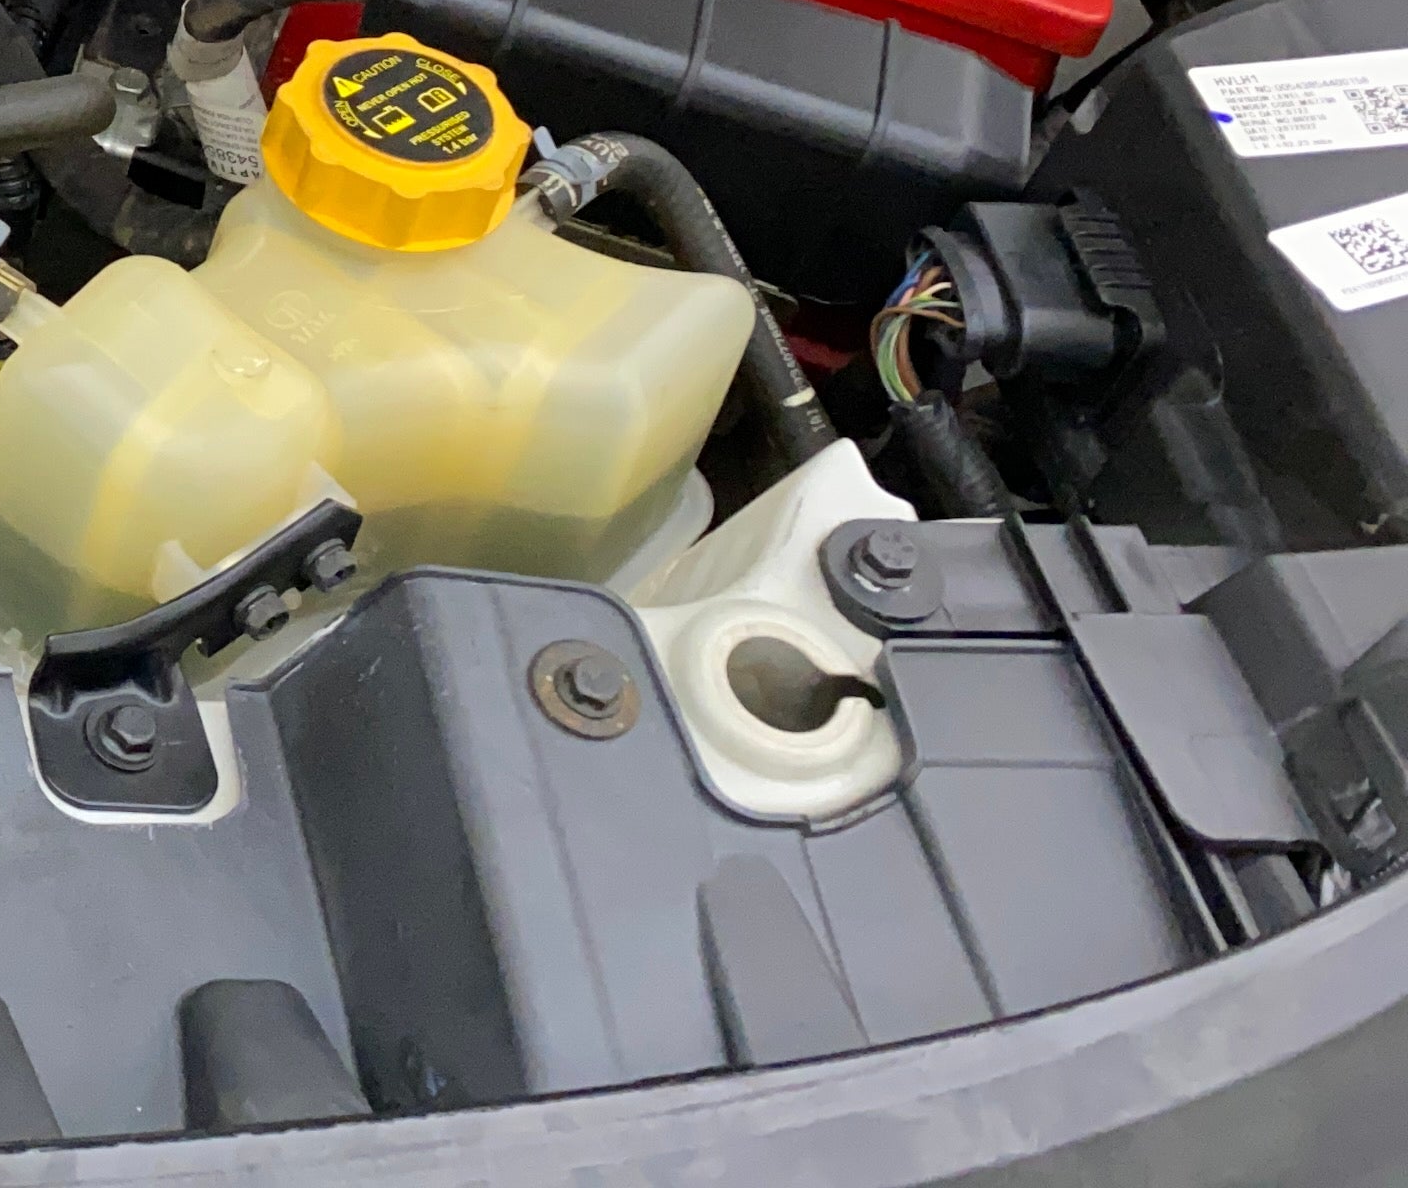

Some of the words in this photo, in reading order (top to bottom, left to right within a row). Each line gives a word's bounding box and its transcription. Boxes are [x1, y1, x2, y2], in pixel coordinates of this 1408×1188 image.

[352, 55, 403, 83] CAUTION
[415, 57, 462, 85] CLOSE
[1213, 74, 1259, 87] HVLH1
[356, 93, 386, 112] NEVER
[384, 81, 409, 99] OPEN
[334, 100, 359, 128] OPEN
[408, 110, 472, 146] PRESSURISED
[431, 124, 470, 147] SYSTEM
[442, 140, 462, 155] 1.4
[459, 132, 479, 147] bar
